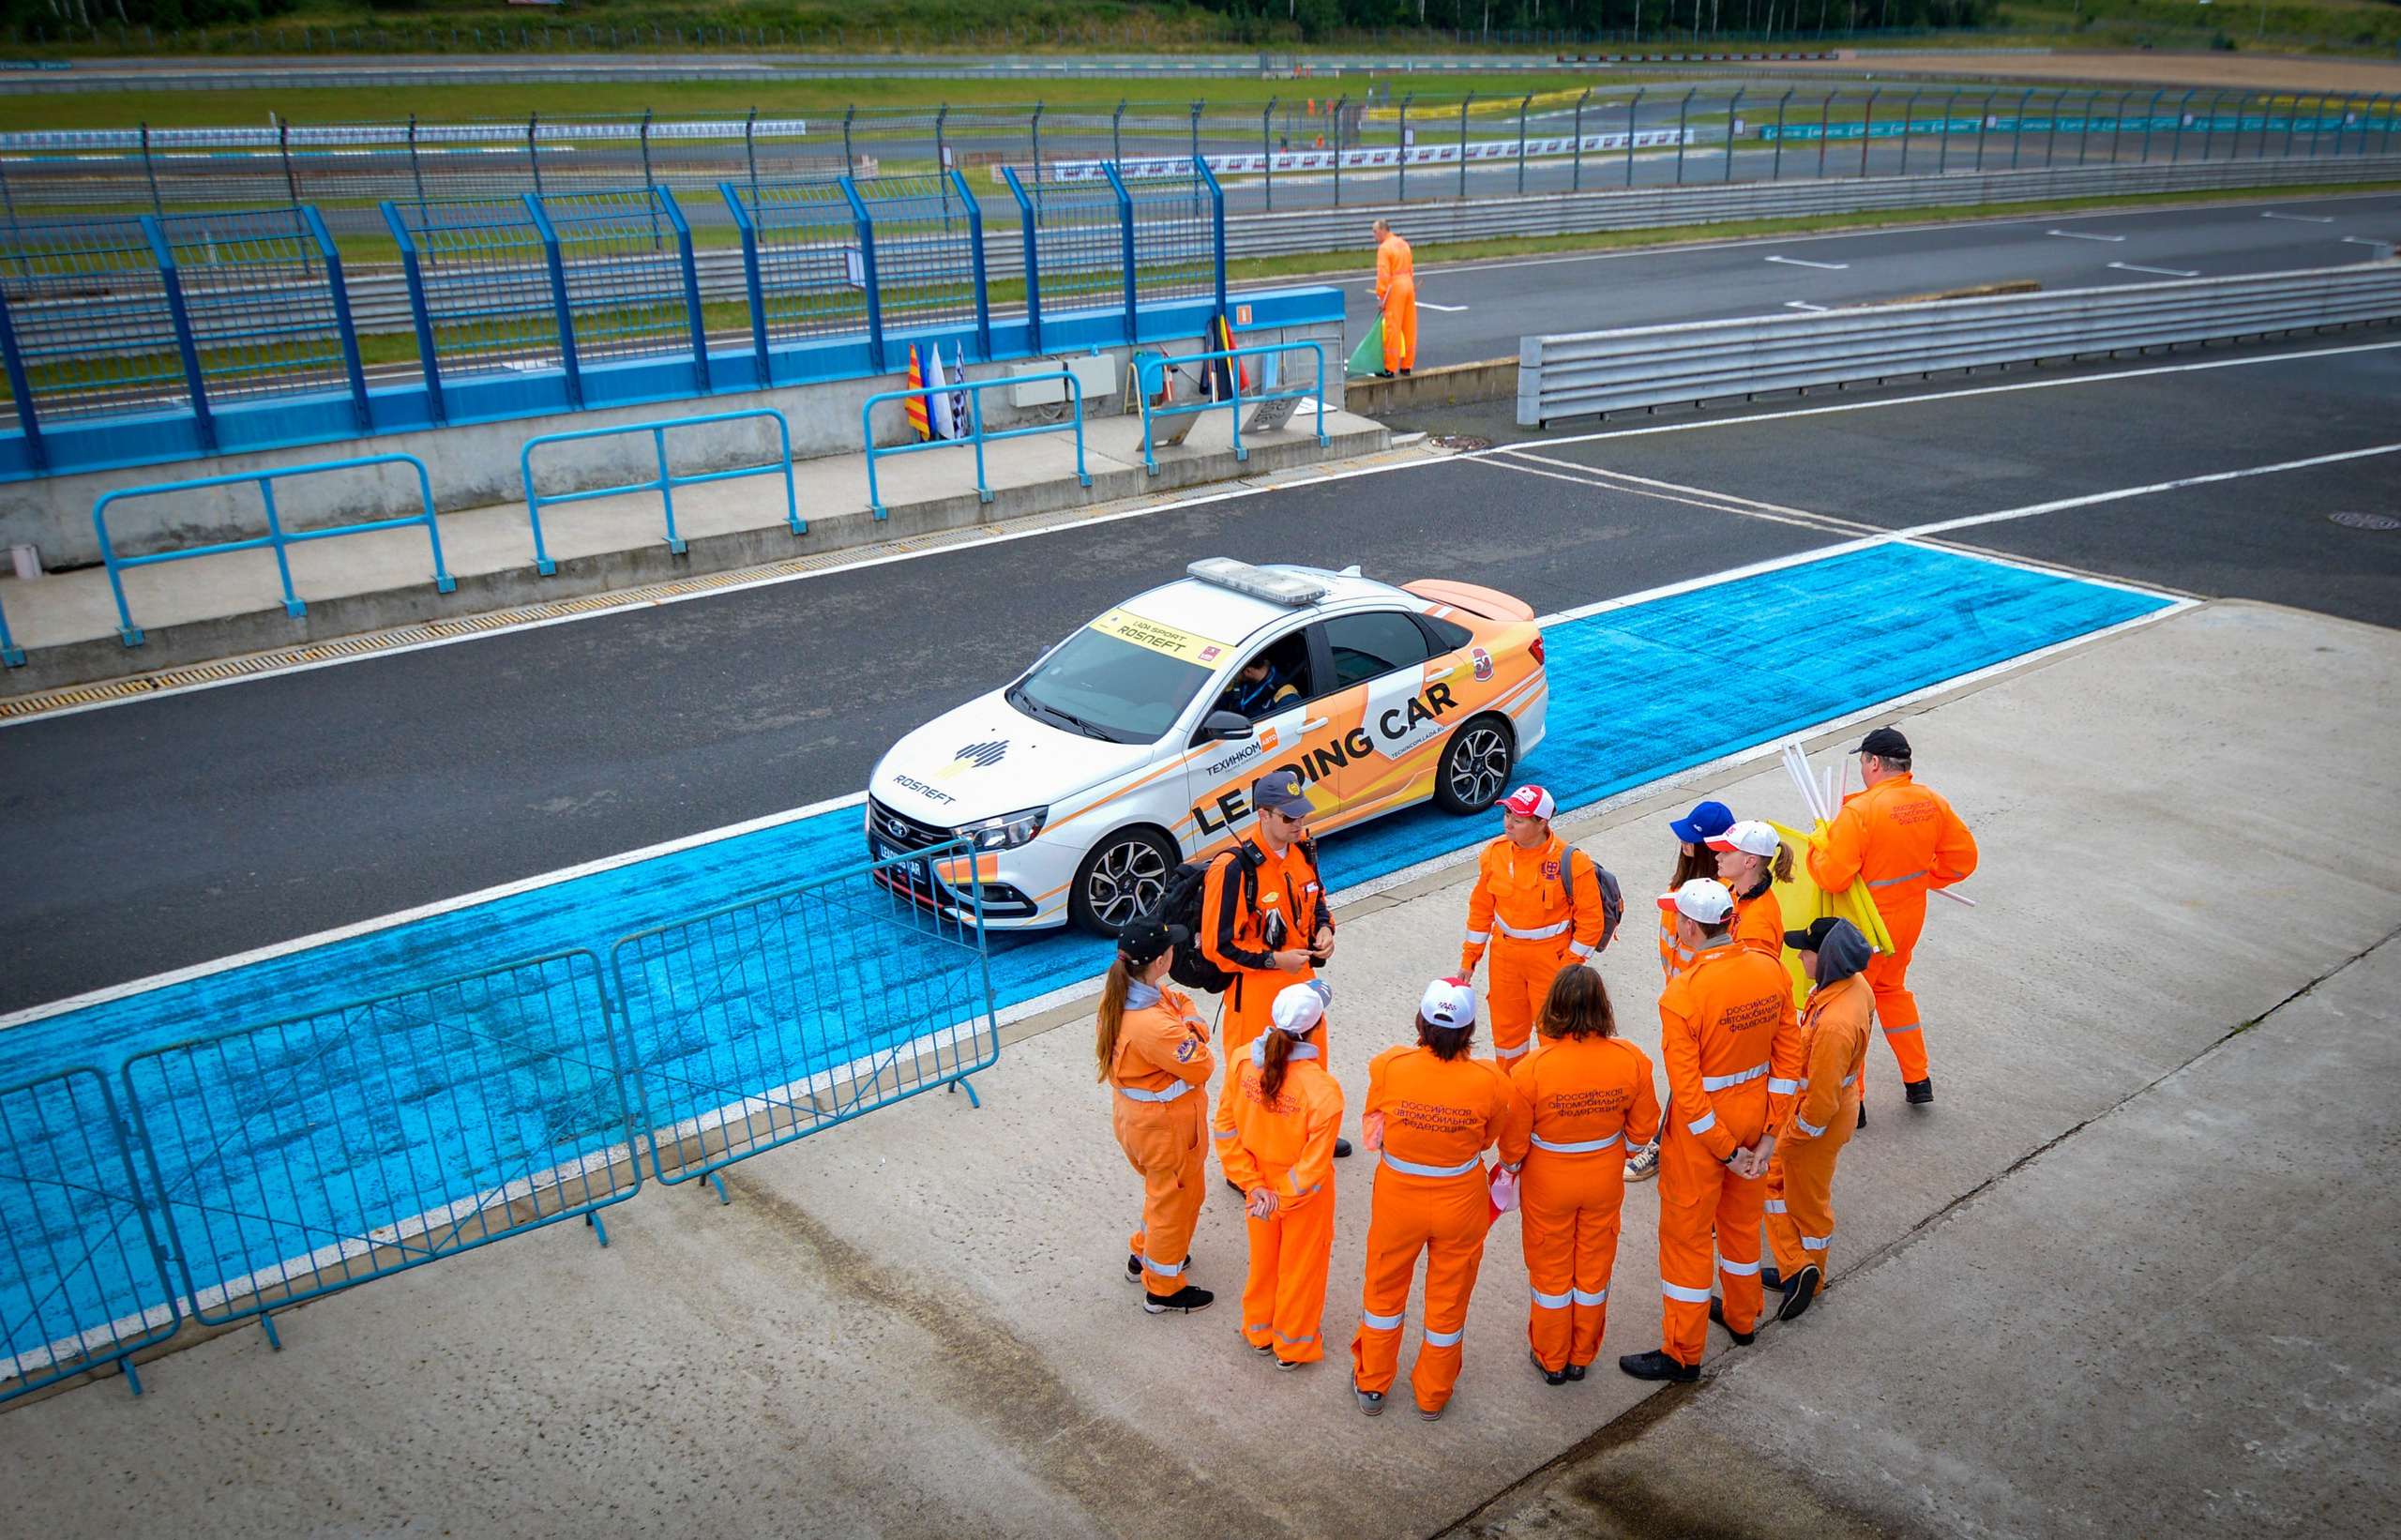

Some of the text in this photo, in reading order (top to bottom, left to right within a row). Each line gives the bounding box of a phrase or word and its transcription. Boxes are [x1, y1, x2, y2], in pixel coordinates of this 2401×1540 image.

[1116, 625, 1187, 653] ROSNEFT
[1151, 627, 1187, 642] SPORT
[1473, 654, 1493, 673] 50
[1379, 681, 1459, 740] CAR
[1261, 734, 1276, 747] АВТО
[1391, 725, 1445, 759] TECHINCOM.LADA.RU
[1206, 741, 1262, 777] ТЕХИНКОМ
[893, 775, 957, 806] ROSNEFT
[1726, 993, 1778, 1017] российская
[1729, 1012, 1778, 1033] федерация
[1548, 1095, 1629, 1109] автомобильная
[1556, 1087, 1623, 1103] российская
[1393, 1108, 1478, 1125] автомобильная
[1401, 1100, 1472, 1117] российская
